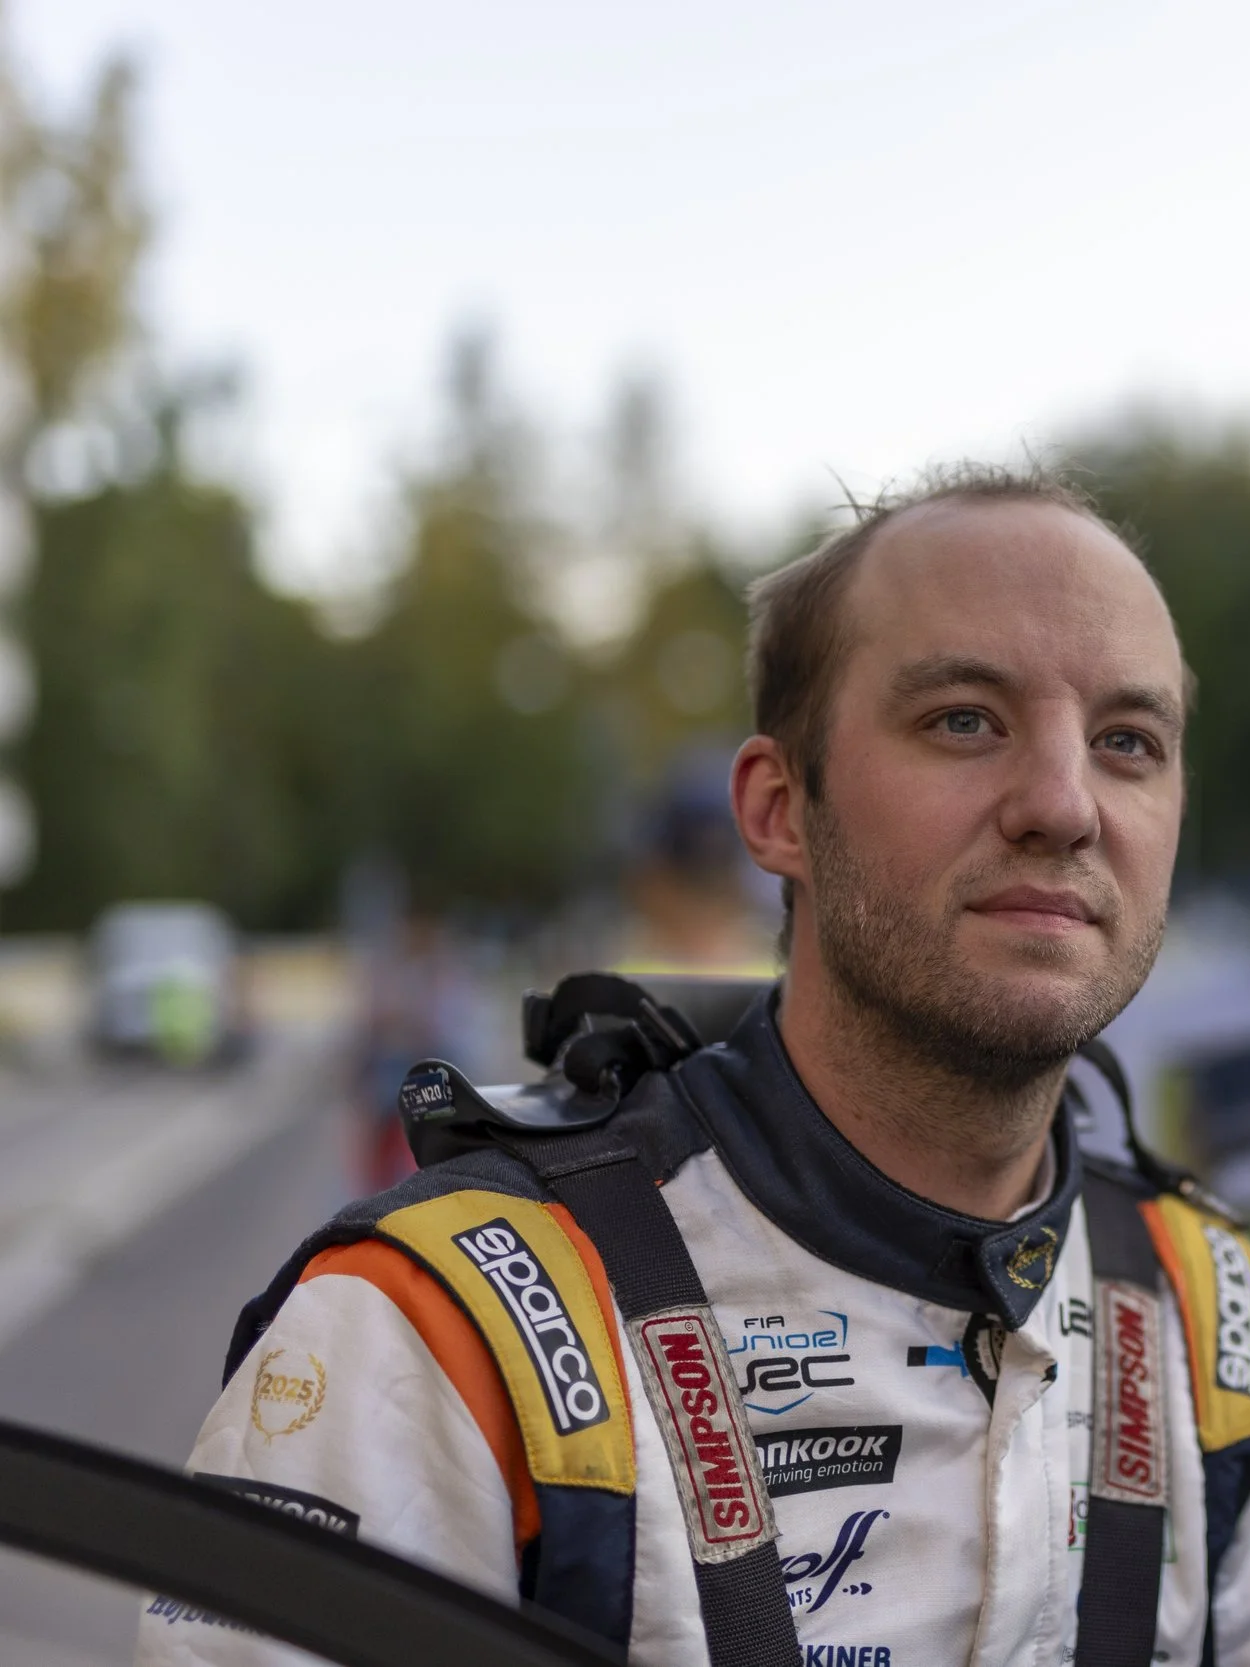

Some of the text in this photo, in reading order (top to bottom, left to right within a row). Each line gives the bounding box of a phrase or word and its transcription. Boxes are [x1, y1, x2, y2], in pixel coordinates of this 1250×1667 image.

[459, 1227, 601, 1429] sparco
[723, 1330, 838, 1355] UNIOR
[743, 1315, 785, 1329] FIA
[259, 1372, 315, 1400] 2025
[1115, 1301, 1153, 1485] SIMPSON
[657, 1332, 750, 1529] SIMPSON
[763, 1459, 879, 1487] driving emotion
[779, 1509, 885, 1613] olf
